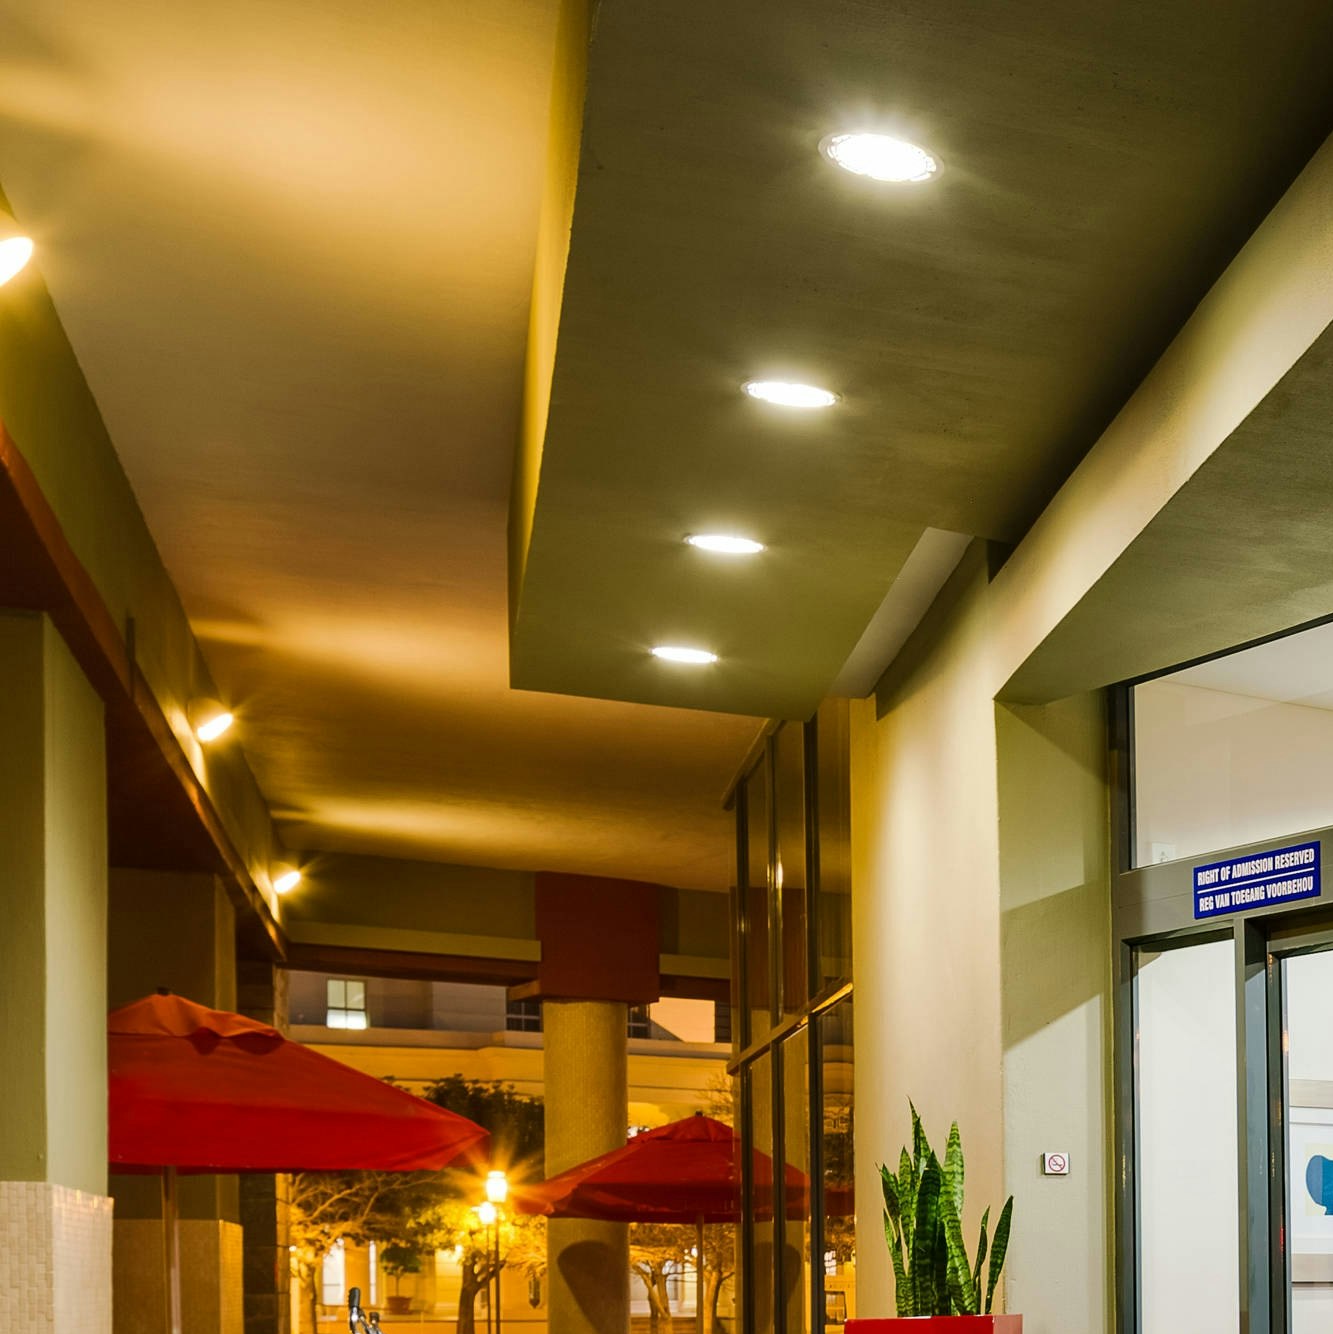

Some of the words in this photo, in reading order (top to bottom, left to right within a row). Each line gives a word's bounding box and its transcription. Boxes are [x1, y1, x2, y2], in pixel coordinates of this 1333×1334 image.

[1198, 869, 1219, 886] RIGHT
[1220, 866, 1230, 881] OF
[1232, 858, 1273, 878] ADMISSION
[1275, 848, 1314, 870] RESERVED
[1200, 896, 1214, 912] REG
[1215, 893, 1230, 908] VAN
[1231, 886, 1265, 905] TOEGANG
[1266, 876, 1313, 898] VOORBEHOU
